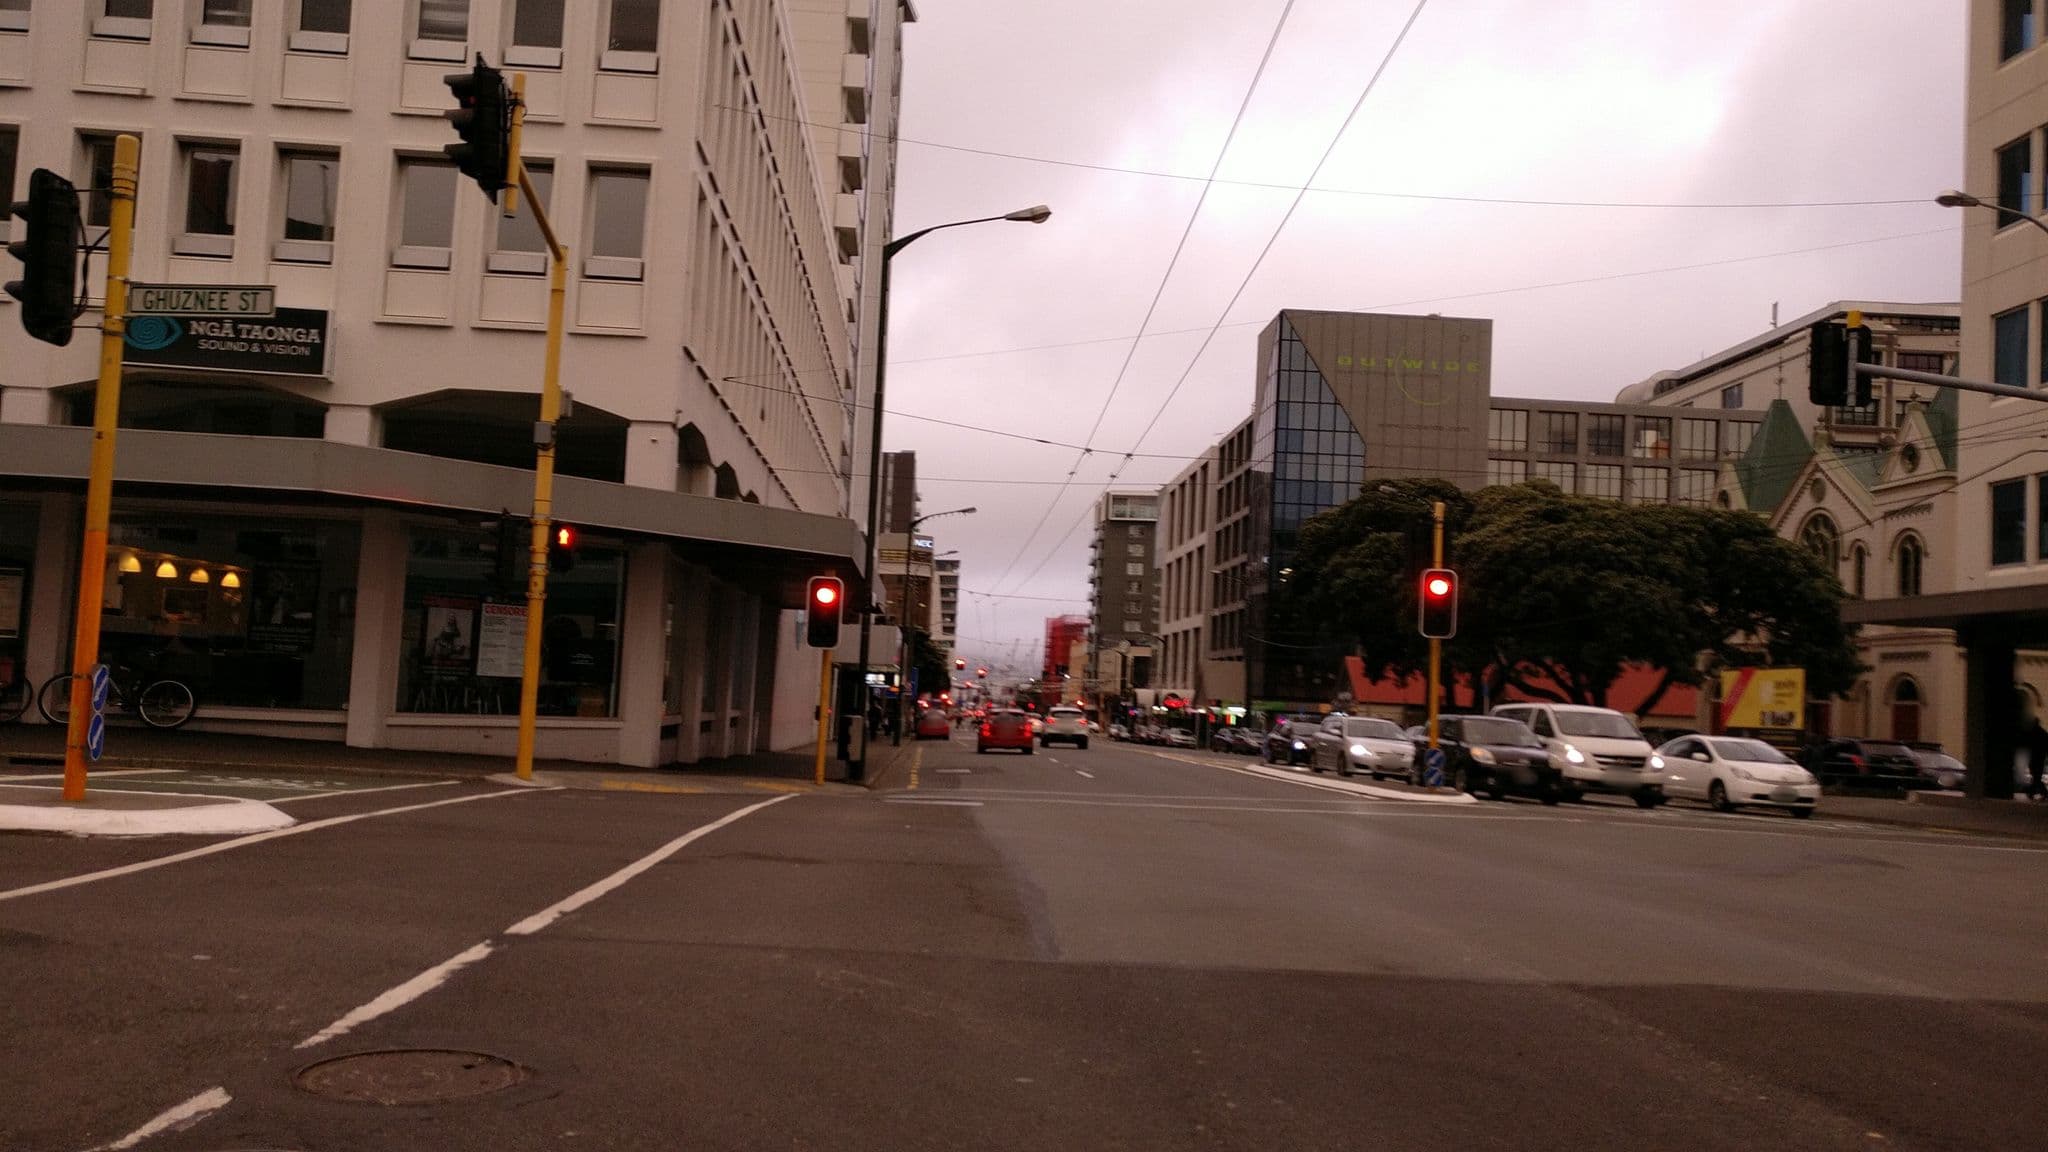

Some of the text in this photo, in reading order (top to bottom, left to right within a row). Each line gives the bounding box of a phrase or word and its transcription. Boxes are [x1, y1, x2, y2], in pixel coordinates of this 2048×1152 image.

[144, 290, 260, 311] GHUZNEE ST
[190, 320, 321, 343] NGĀ TAONGA
[199, 339, 311, 356] SOUND & VISION
[486, 604, 528, 617] CENSORE
